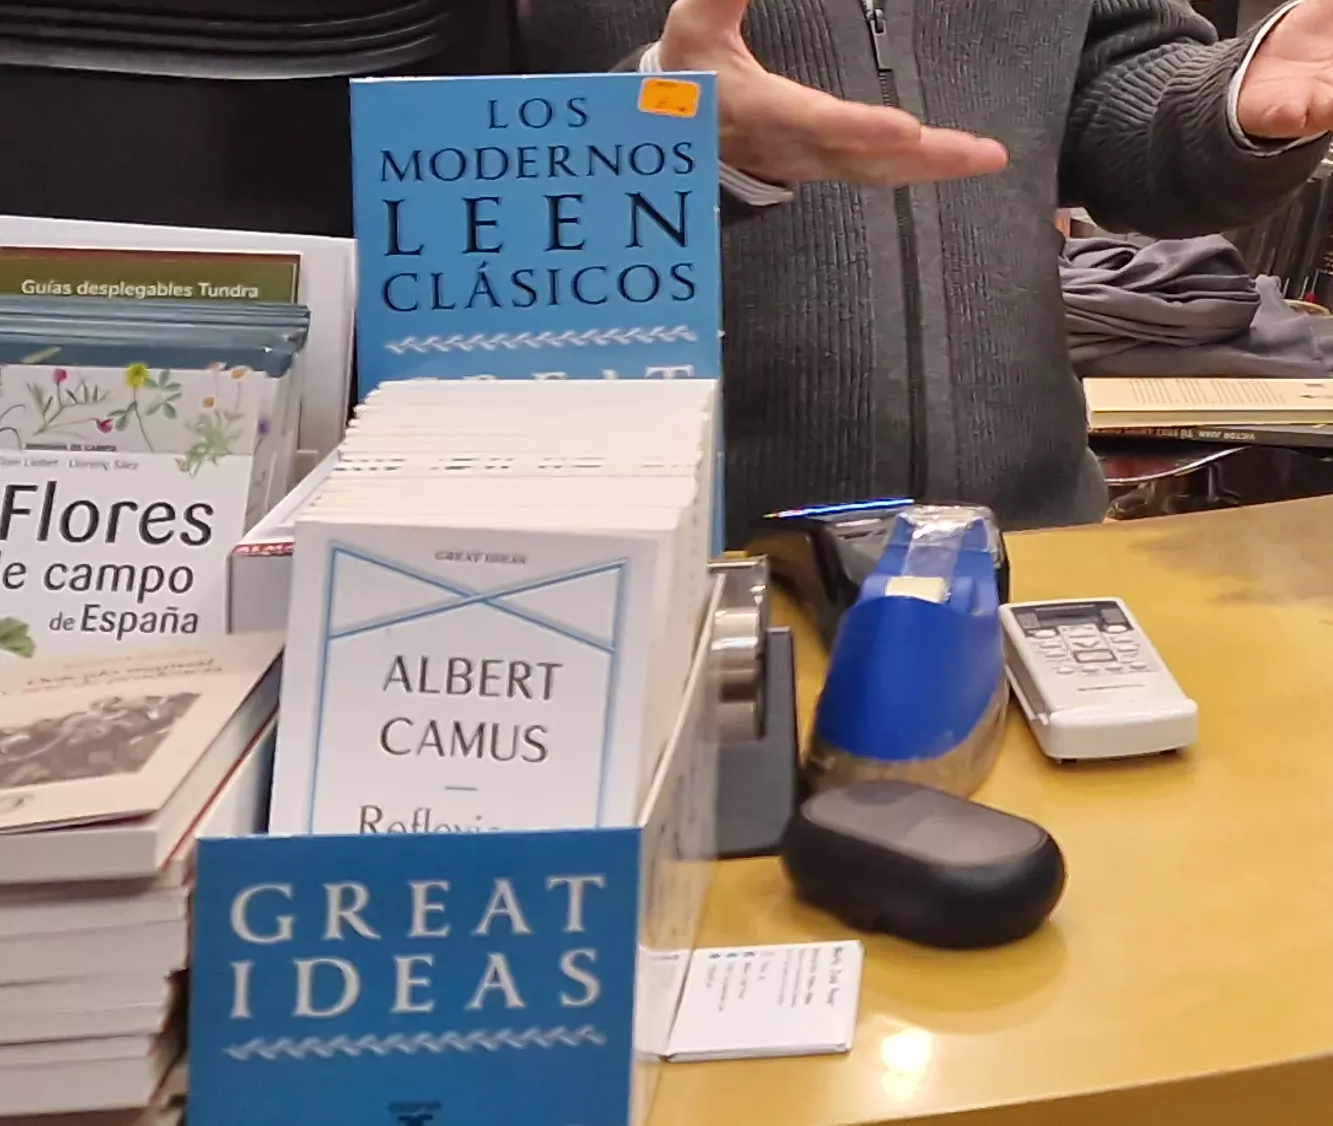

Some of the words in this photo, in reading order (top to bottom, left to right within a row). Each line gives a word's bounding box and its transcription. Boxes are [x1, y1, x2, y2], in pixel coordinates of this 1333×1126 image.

[488, 97, 589, 130] LOS
[380, 142, 695, 182] MODERNOS
[382, 190, 693, 257] LEEN
[21, 279, 71, 295] Guías
[77, 281, 193, 298] desplegables
[198, 282, 258, 298] Tundra
[382, 260, 696, 312] CLÁSICOS
[0, 480, 214, 546] Flores
[0, 550, 27, 590] e
[43, 562, 194, 604] campo
[435, 550, 481, 563] GREAT
[484, 553, 527, 564] IDEAS
[49, 611, 76, 631] de
[81, 604, 199, 641] España
[382, 654, 563, 701] ALBERT
[379, 717, 549, 763] CAMUS
[229, 874, 606, 944] GREAT
[229, 947, 602, 1019] IDEAS
